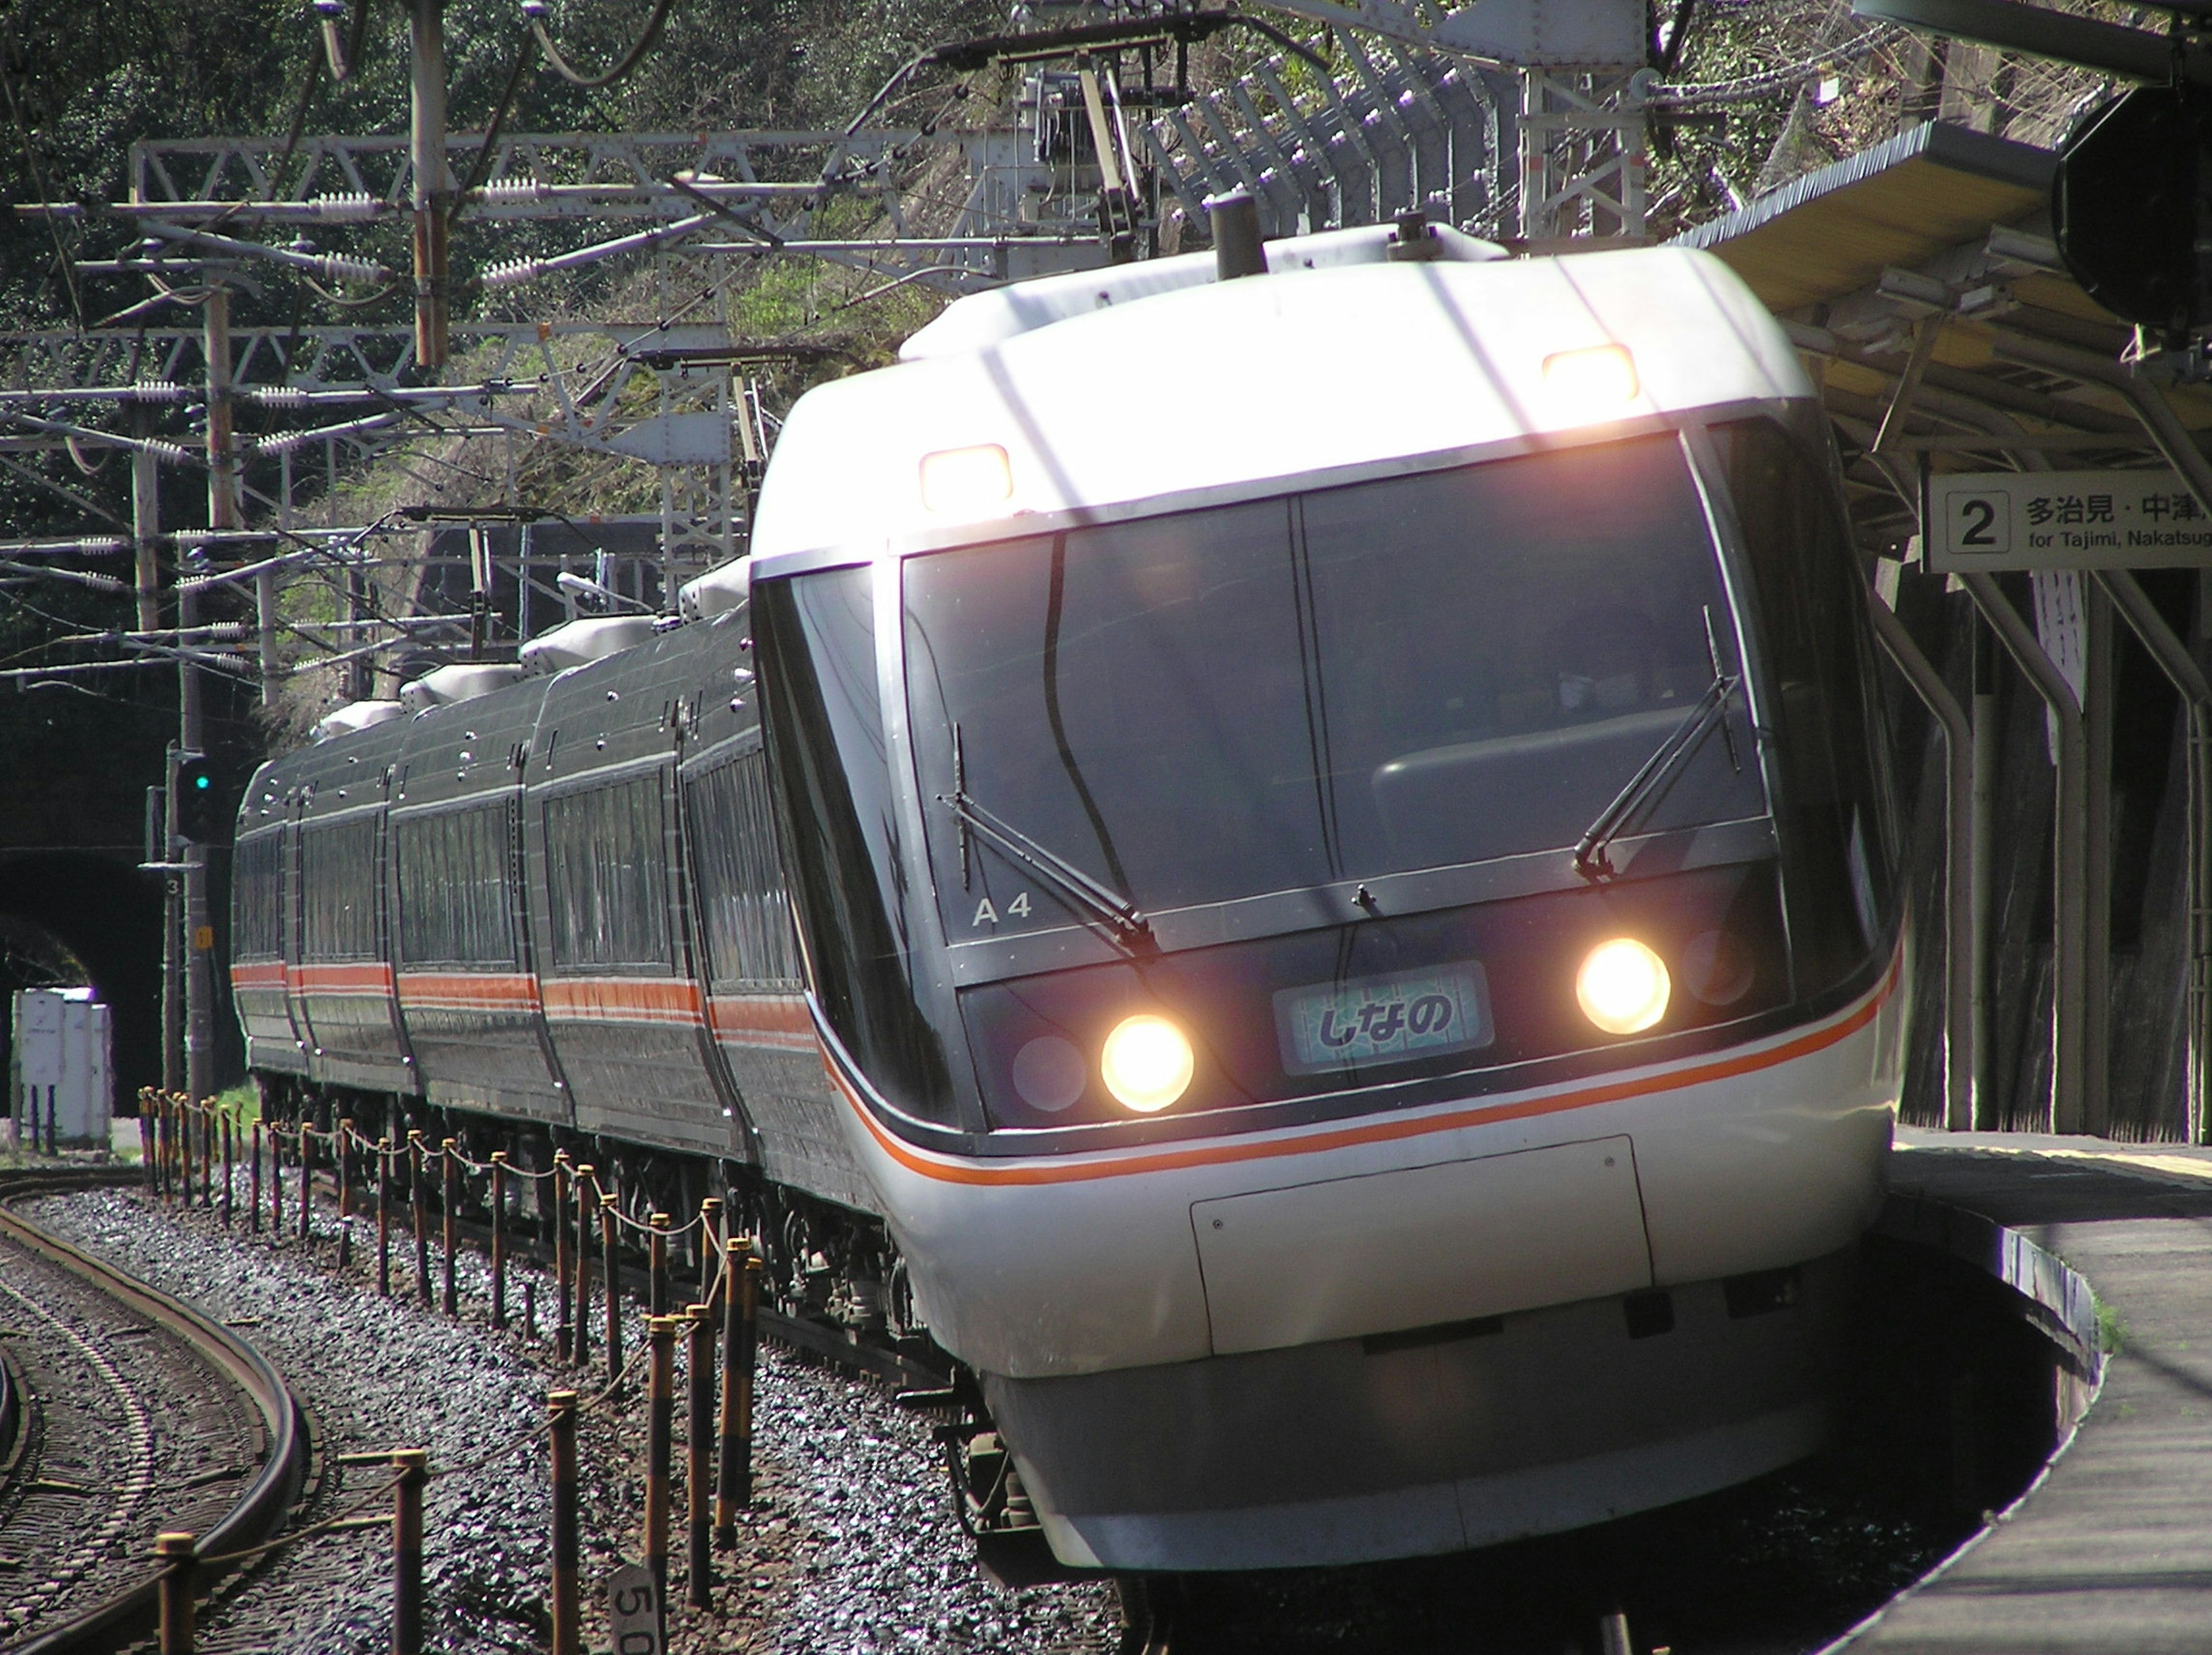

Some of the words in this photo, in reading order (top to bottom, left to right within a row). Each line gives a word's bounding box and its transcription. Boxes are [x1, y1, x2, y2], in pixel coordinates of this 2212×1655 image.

[1961, 499, 1997, 546] 2
[2027, 493, 2206, 526] 多治見・中津
[2029, 531, 2054, 548] for
[2059, 531, 2122, 551] Tajimi,
[166, 879, 179, 894] 3
[1319, 994, 1453, 1047] しなの
